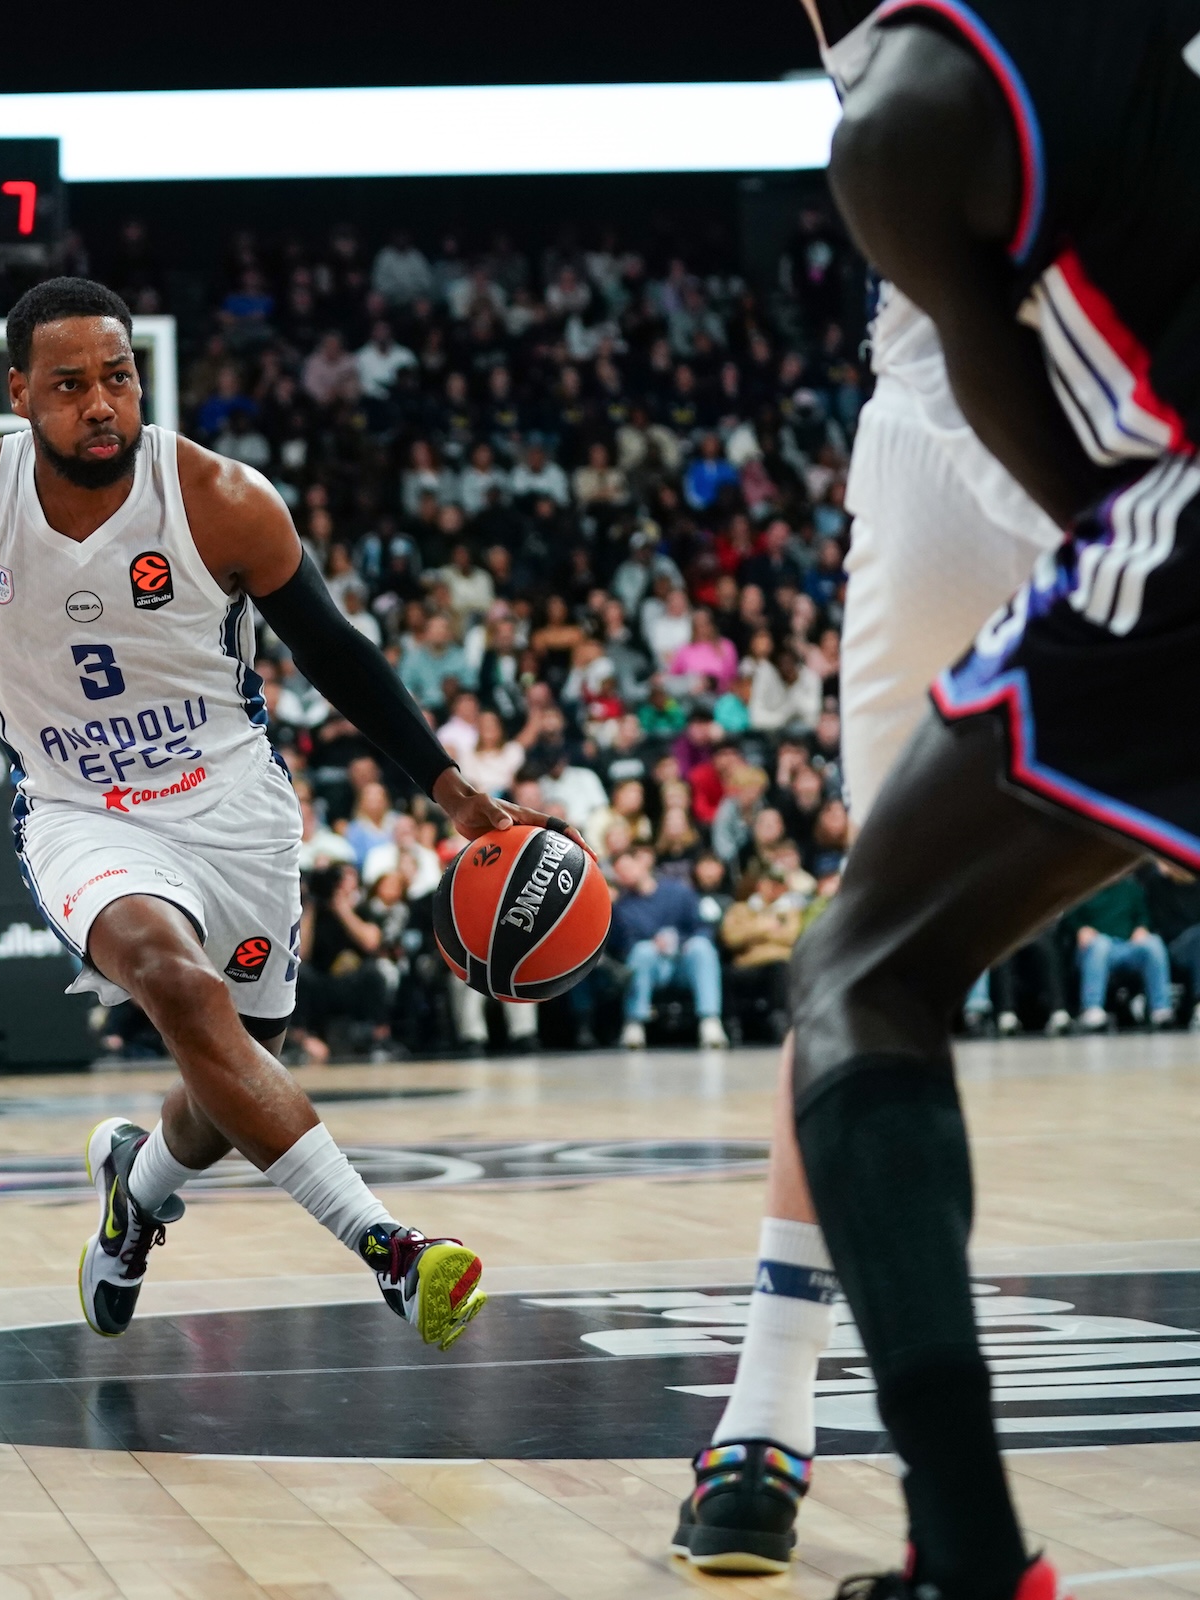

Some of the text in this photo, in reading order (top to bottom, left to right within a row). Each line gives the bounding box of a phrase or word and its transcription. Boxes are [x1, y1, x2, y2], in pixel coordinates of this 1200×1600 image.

[1, 180, 37, 235] 7
[70, 644, 126, 700] 3
[40, 696, 207, 762] ANADOLU
[78, 735, 202, 784] EFES
[131, 767, 207, 805] corendon
[72, 868, 129, 903] corendon
